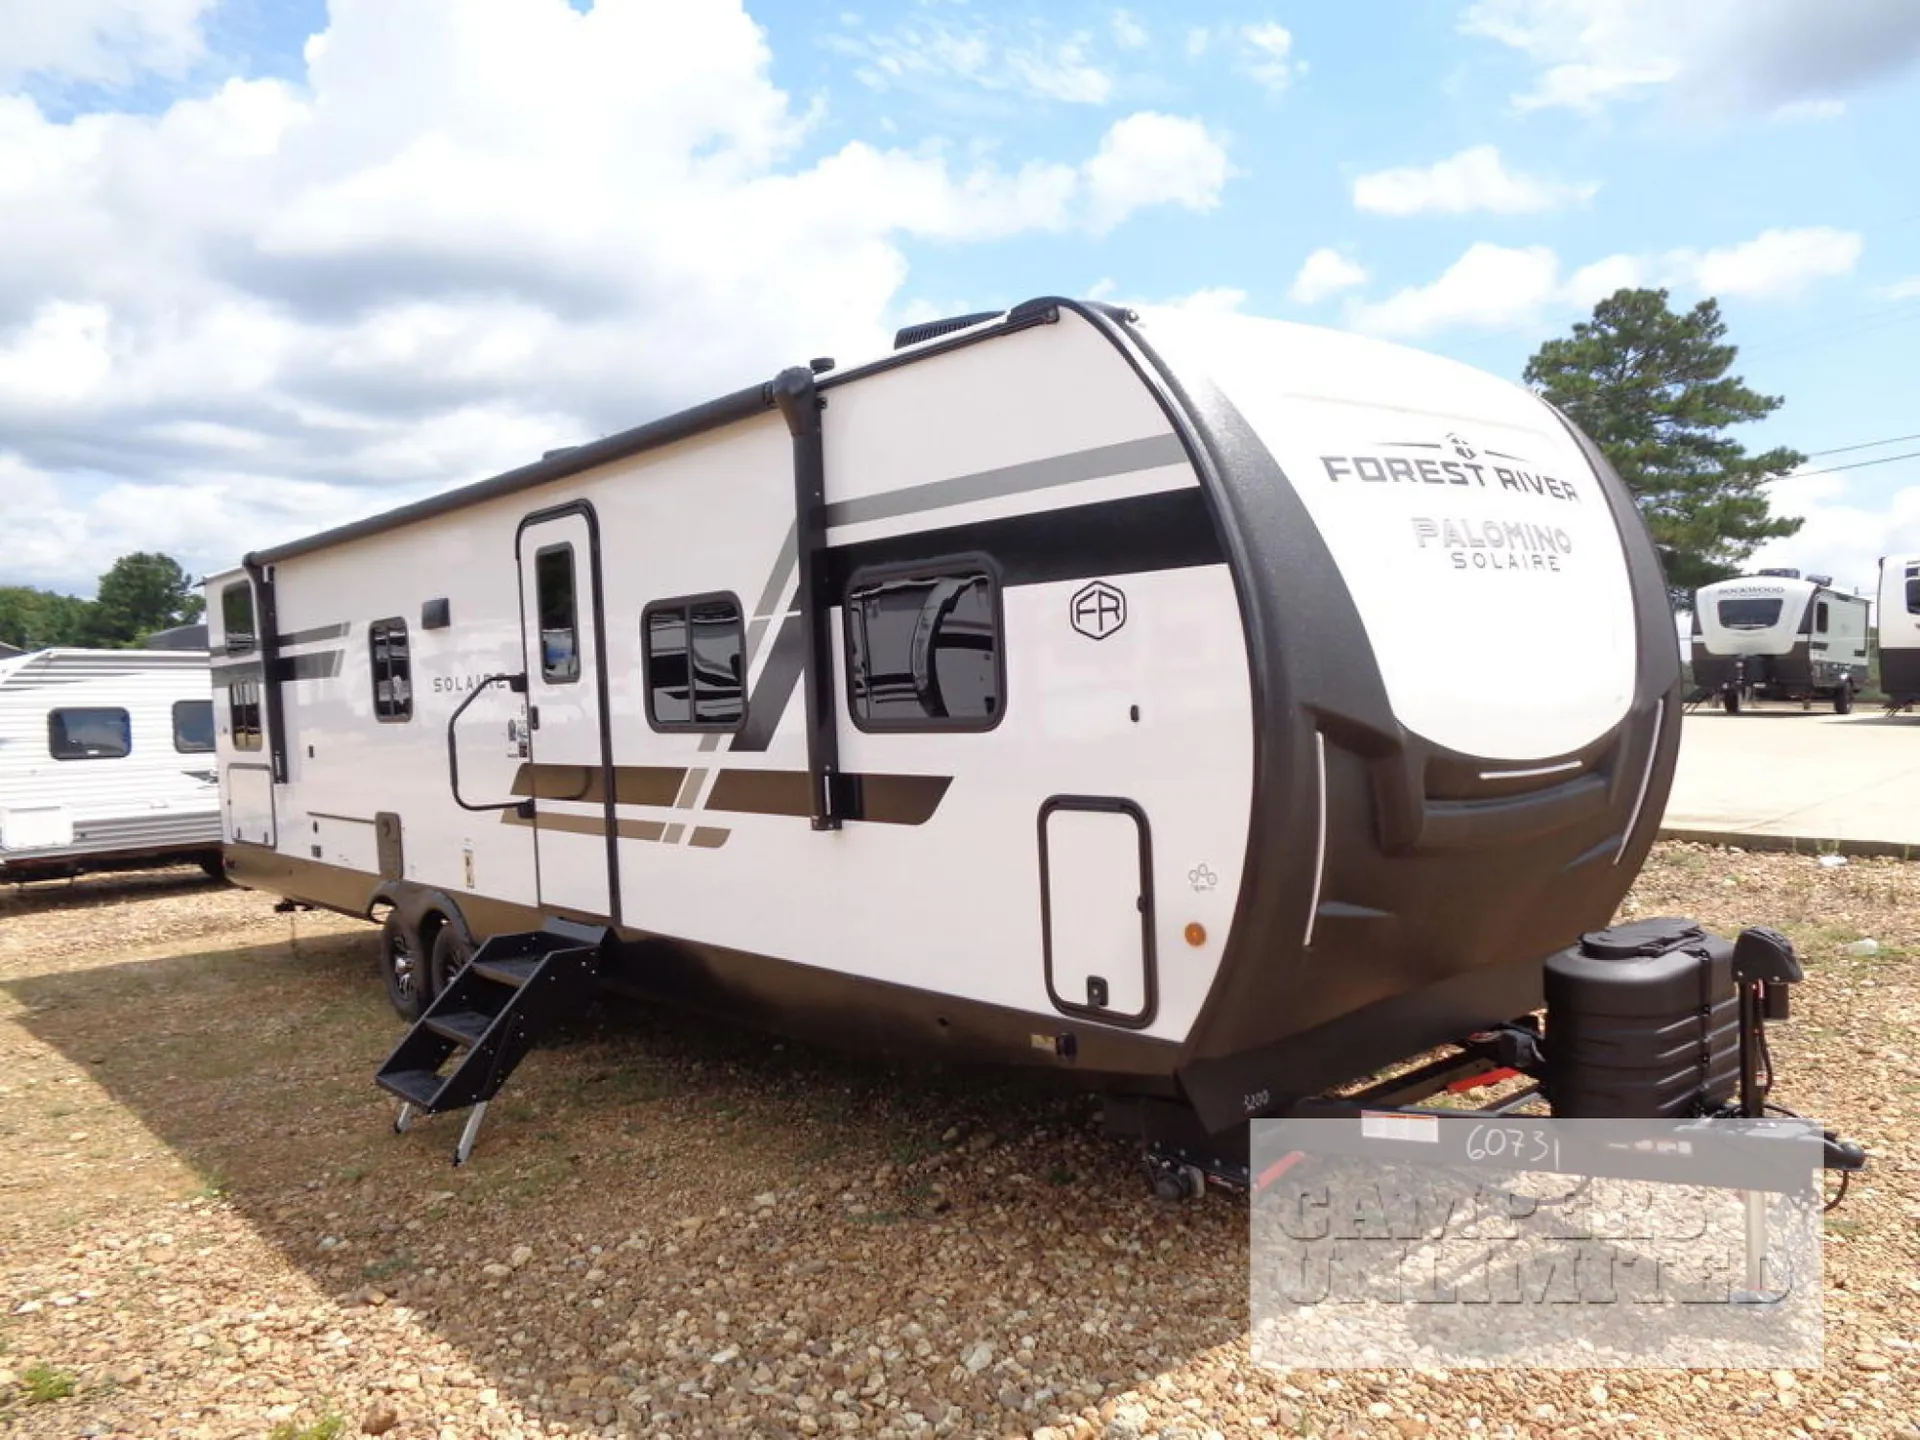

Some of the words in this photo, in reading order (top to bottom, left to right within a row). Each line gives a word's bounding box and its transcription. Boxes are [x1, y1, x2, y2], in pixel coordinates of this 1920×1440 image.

[1319, 456, 1486, 487] FOREST
[1493, 465, 1578, 502] RIVER
[1411, 517, 1571, 554] PALOMINO
[1451, 552, 1561, 572] SOLAIRE
[1466, 1124, 1560, 1171] 60731
